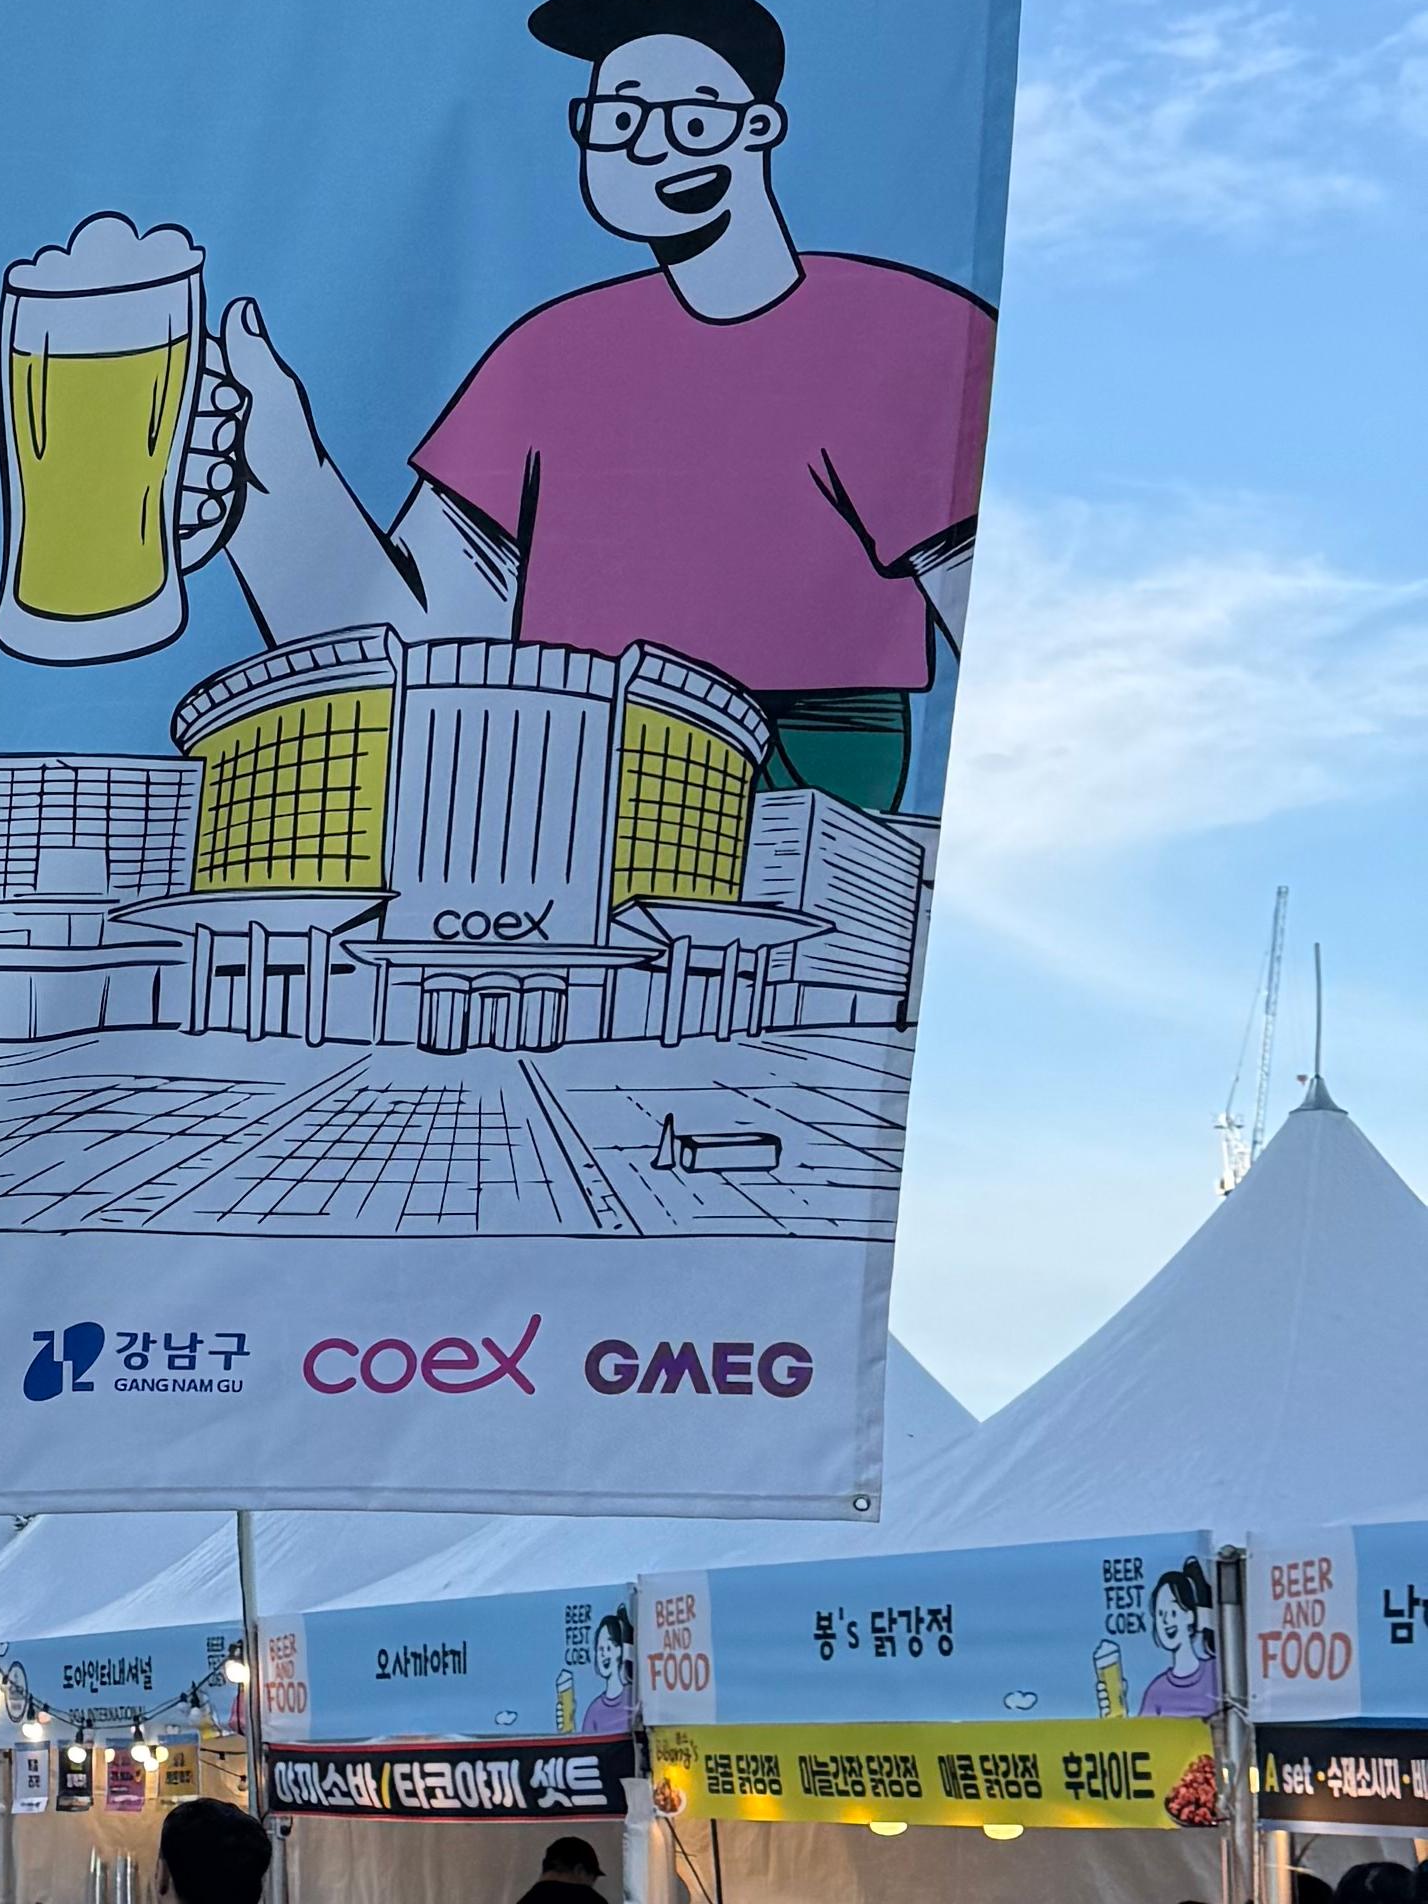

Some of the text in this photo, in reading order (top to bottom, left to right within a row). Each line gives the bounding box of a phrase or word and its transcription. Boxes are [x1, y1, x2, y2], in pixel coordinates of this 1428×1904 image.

[431, 898, 556, 943] coex
[115, 1332, 251, 1371] 강남구
[303, 1313, 542, 1395] coex
[583, 1339, 814, 1399] GMEG
[217, 1379, 243, 1393] GU
[1103, 1557, 1144, 1583] BEER
[1271, 1557, 1334, 1601] BEER
[565, 1605, 592, 1624] BEER
[656, 1594, 696, 1629] BEER
[1104, 1585, 1145, 1610] FEST
[1282, 1598, 1326, 1629] AND
[1383, 1584, 1428, 1644] 남
[565, 1626, 591, 1645] FEST
[663, 1627, 692, 1652] AND
[871, 1604, 954, 1658] 닭강정
[1105, 1612, 1147, 1635] COEX
[376, 1641, 467, 1679] 오사까야끼
[565, 1647, 591, 1665] COEX
[647, 1653, 710, 1692] FOOD
[1258, 1631, 1353, 1682] FOOD
[265, 1682, 307, 1713] FOOD
[530, 1756, 609, 1808] 셋트
[704, 1751, 1155, 1800] 달콤 닭강정 마늘간장 닭강정 매콤 닭강정 후라이드
[1265, 1752, 1280, 1792] A
[1282, 1756, 1315, 1795] set
